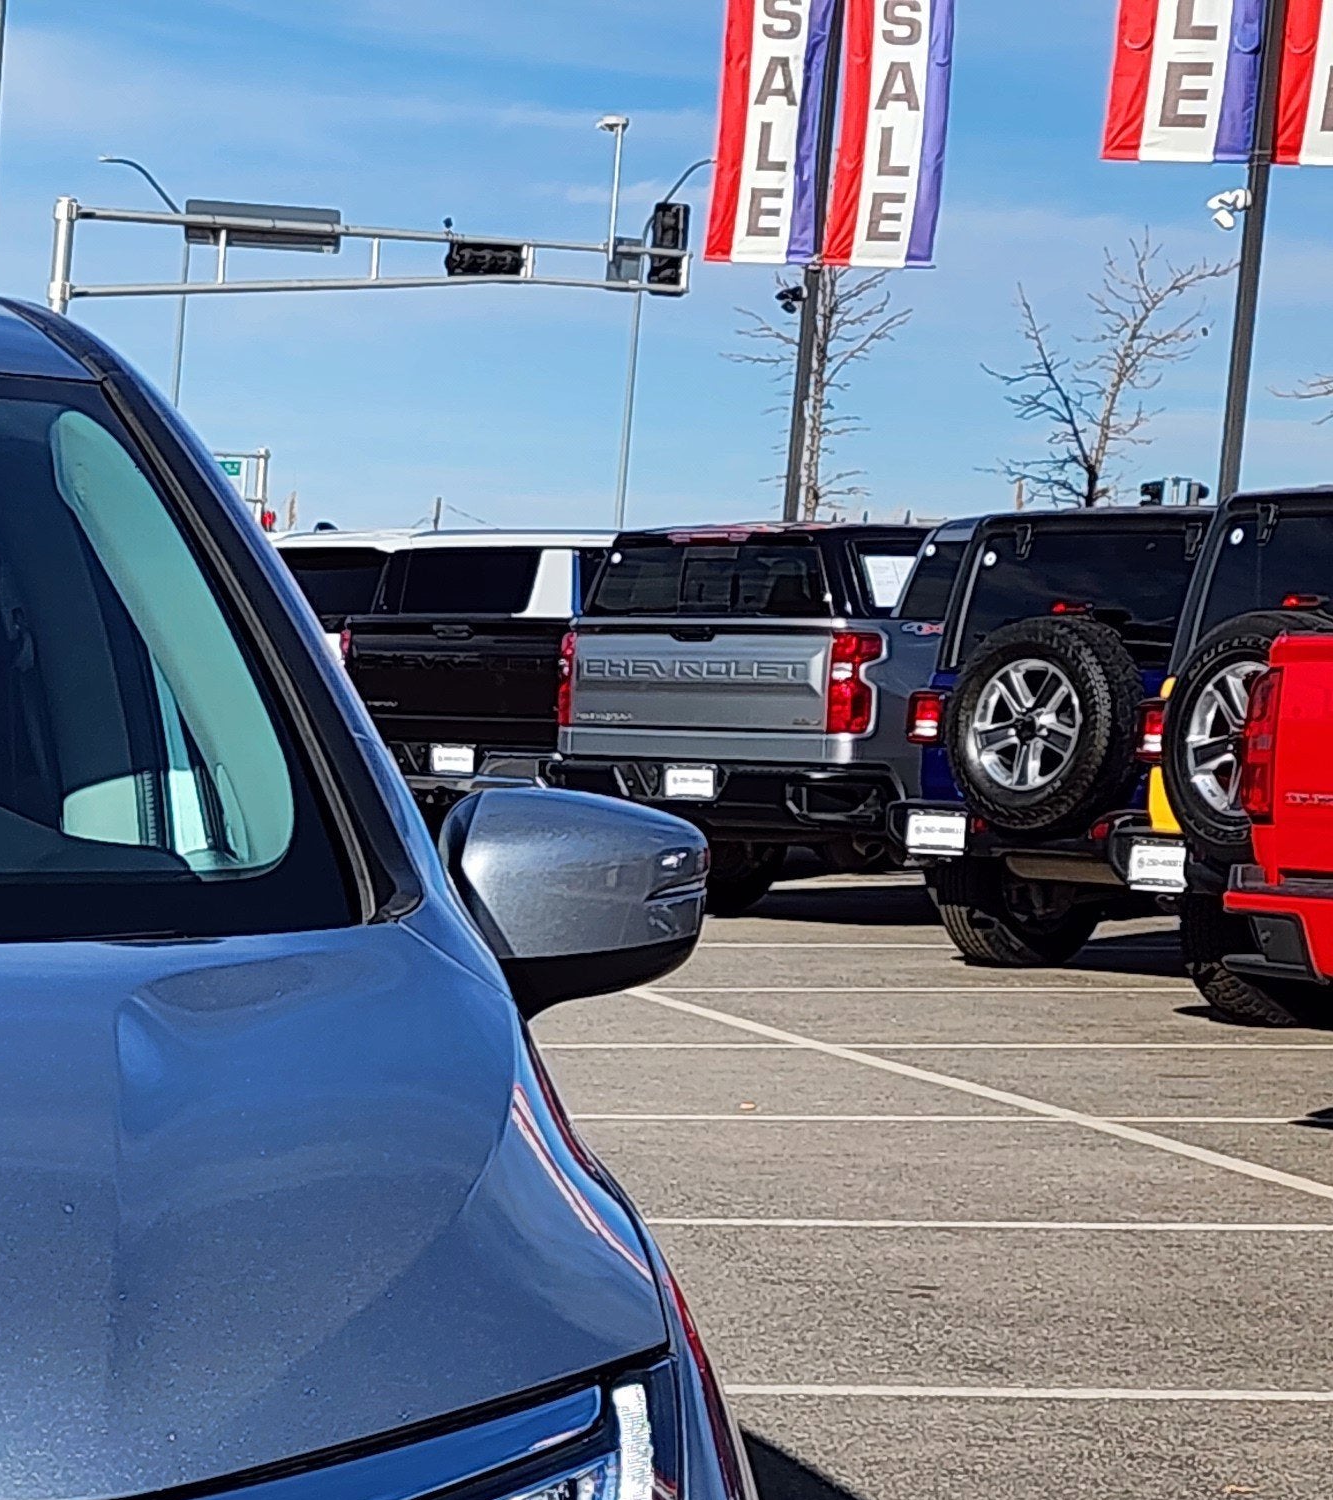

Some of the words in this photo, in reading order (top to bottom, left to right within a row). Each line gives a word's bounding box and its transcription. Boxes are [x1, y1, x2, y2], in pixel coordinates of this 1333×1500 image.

[745, 0, 802, 237] SALE
[865, 0, 923, 241] SALE
[581, 658, 808, 681] CHEVROLET
